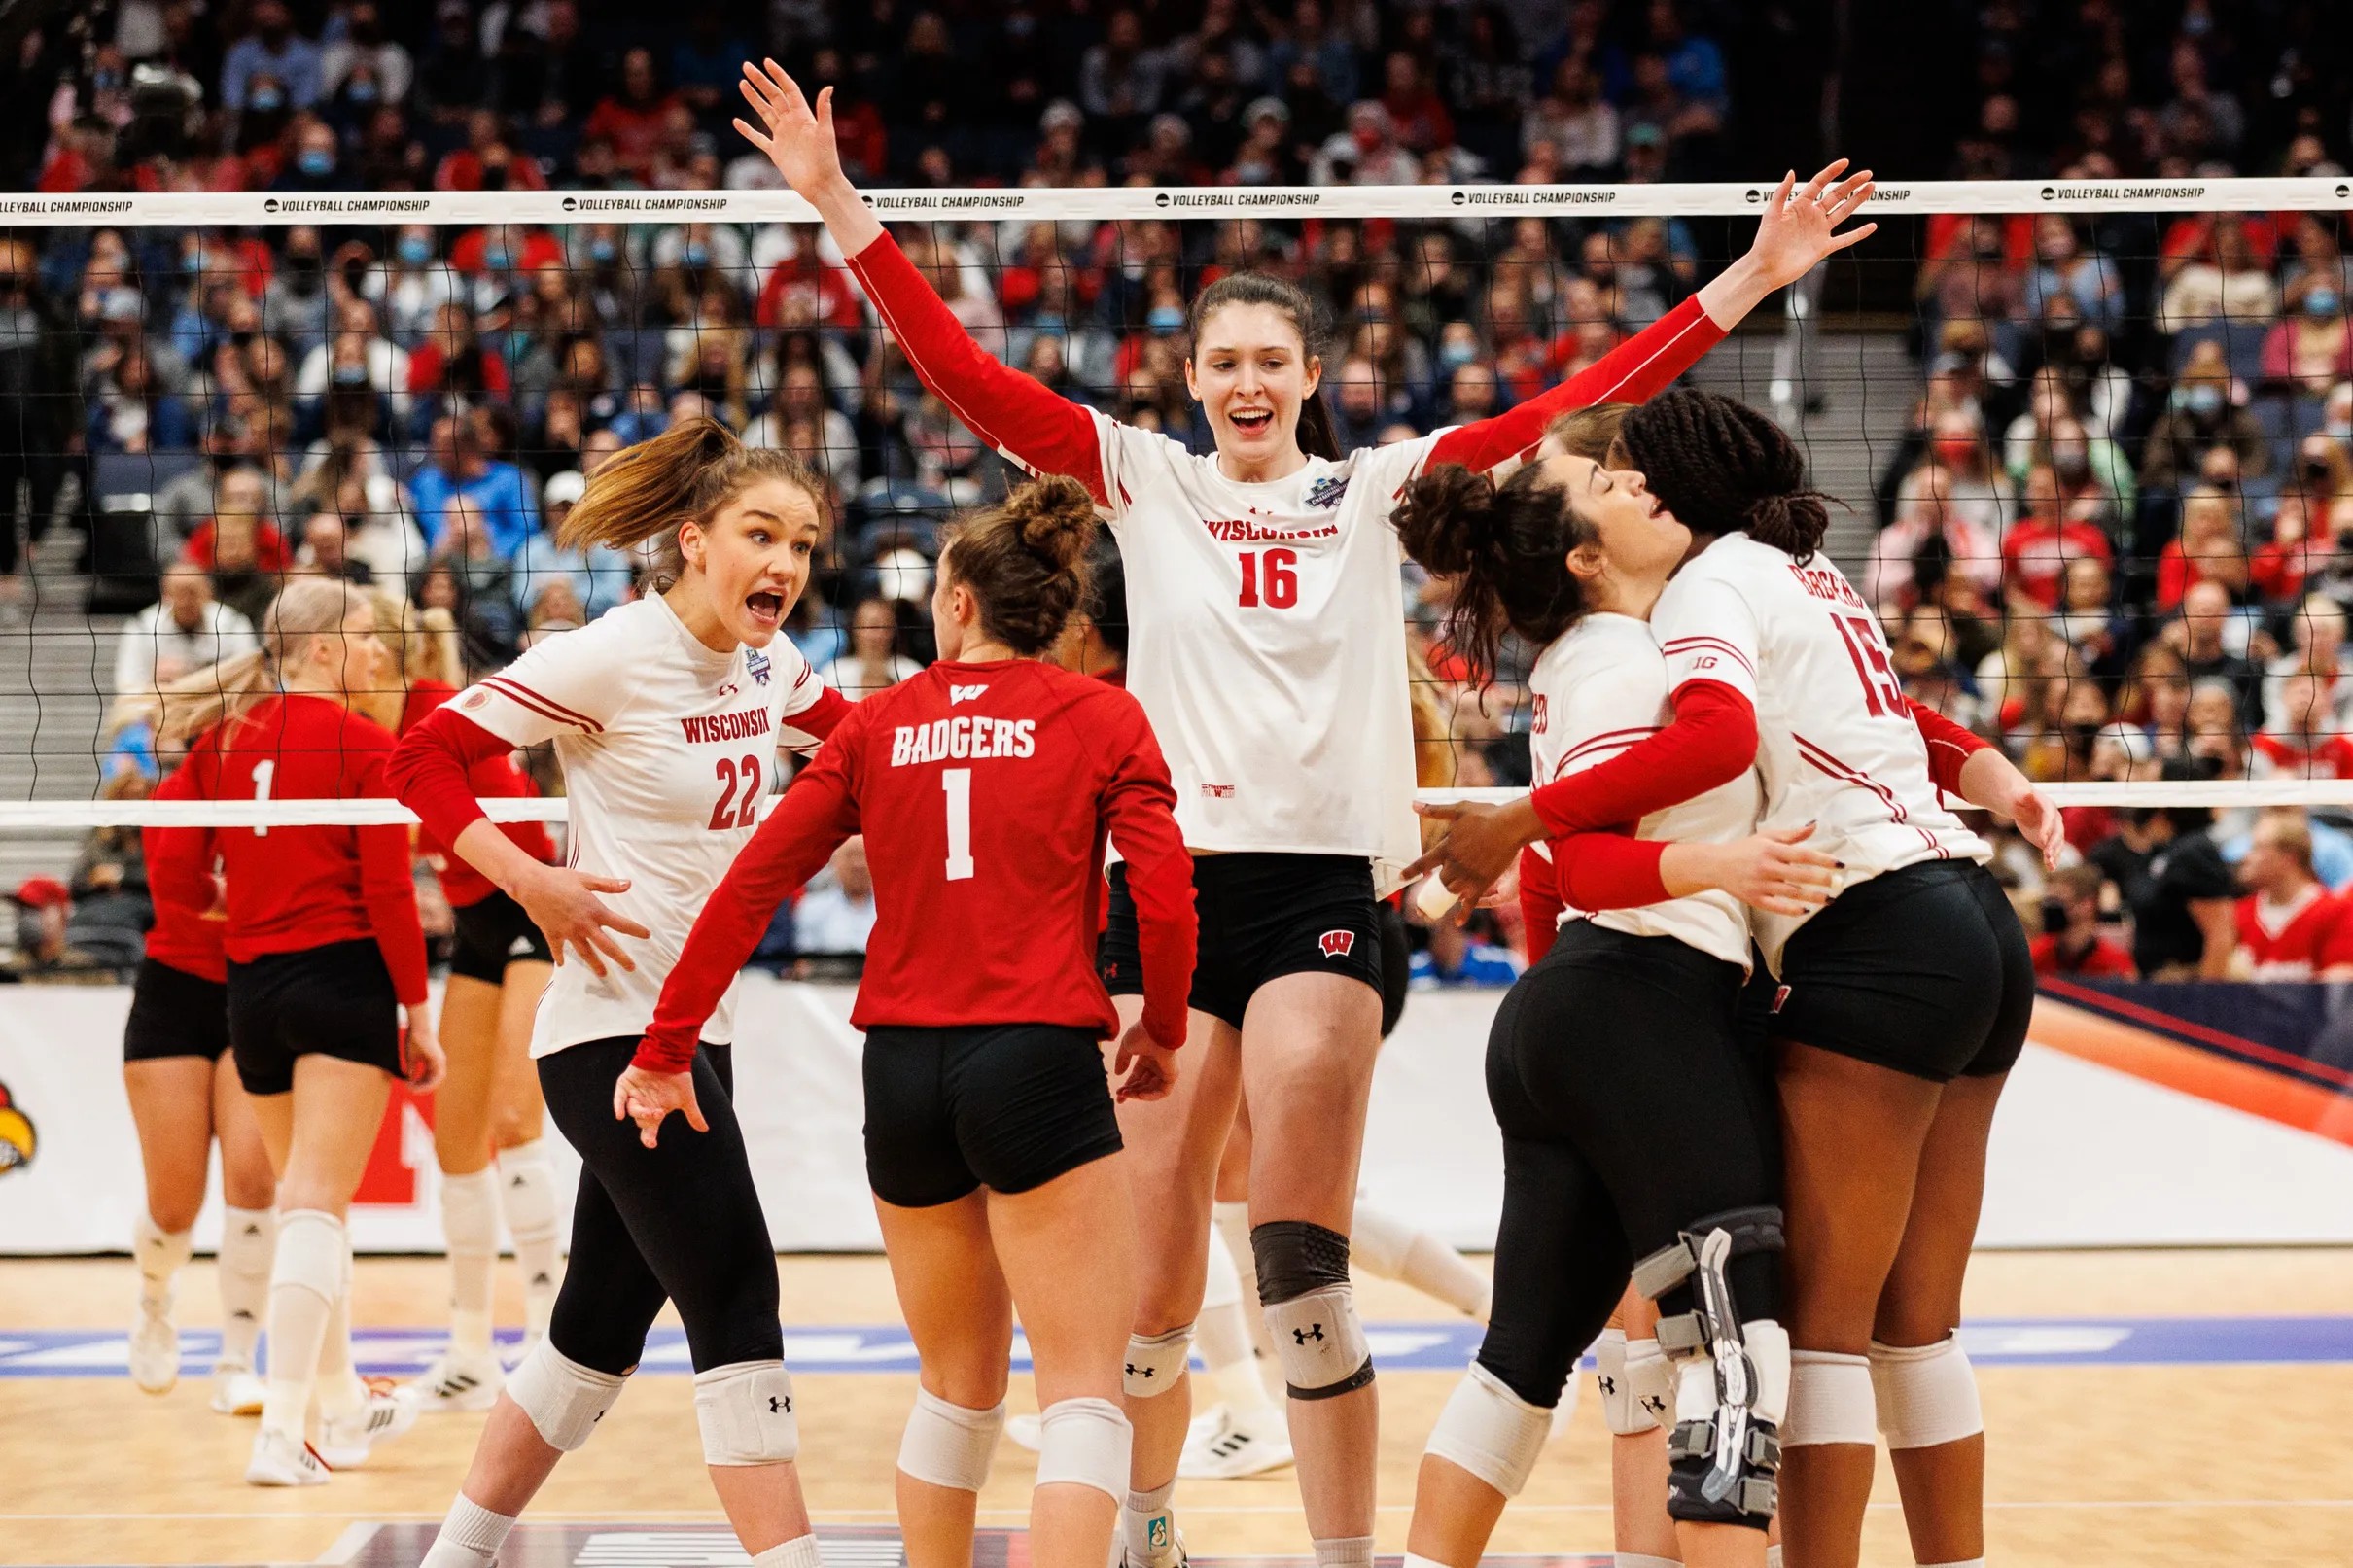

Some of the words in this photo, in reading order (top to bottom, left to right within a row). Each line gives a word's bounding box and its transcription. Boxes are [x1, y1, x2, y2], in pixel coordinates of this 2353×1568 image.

[1173, 195, 1234, 206] VOLLEYBALL
[1238, 194, 1320, 205] CHAMPIONSHIP
[1468, 193, 1529, 204] VOLLEYBALL
[1533, 192, 1616, 203] CHAMPIONSHIP
[2057, 188, 2120, 199] VOLLEYBALL
[2123, 187, 2205, 198] CHAMPIONSHIP
[50, 200, 133, 212] CHAMPIONSHIP
[281, 200, 343, 212] VOLLEYBALL
[347, 199, 430, 212] CHAMPIONSHIP
[579, 199, 642, 210] VOLLEYBALL
[645, 198, 727, 210] CHAMPIONSHIP
[877, 197, 938, 208] VOLLEYBALL
[941, 196, 1025, 208] CHAMPIONSHIP
[1202, 519, 1339, 541] WISCOIN
[1238, 547, 1298, 610] 16
[1829, 612, 1911, 719] 15
[891, 715, 1036, 767] BADGERS
[252, 758, 275, 837] 1
[707, 753, 761, 831] 22
[941, 767, 974, 881] 1
